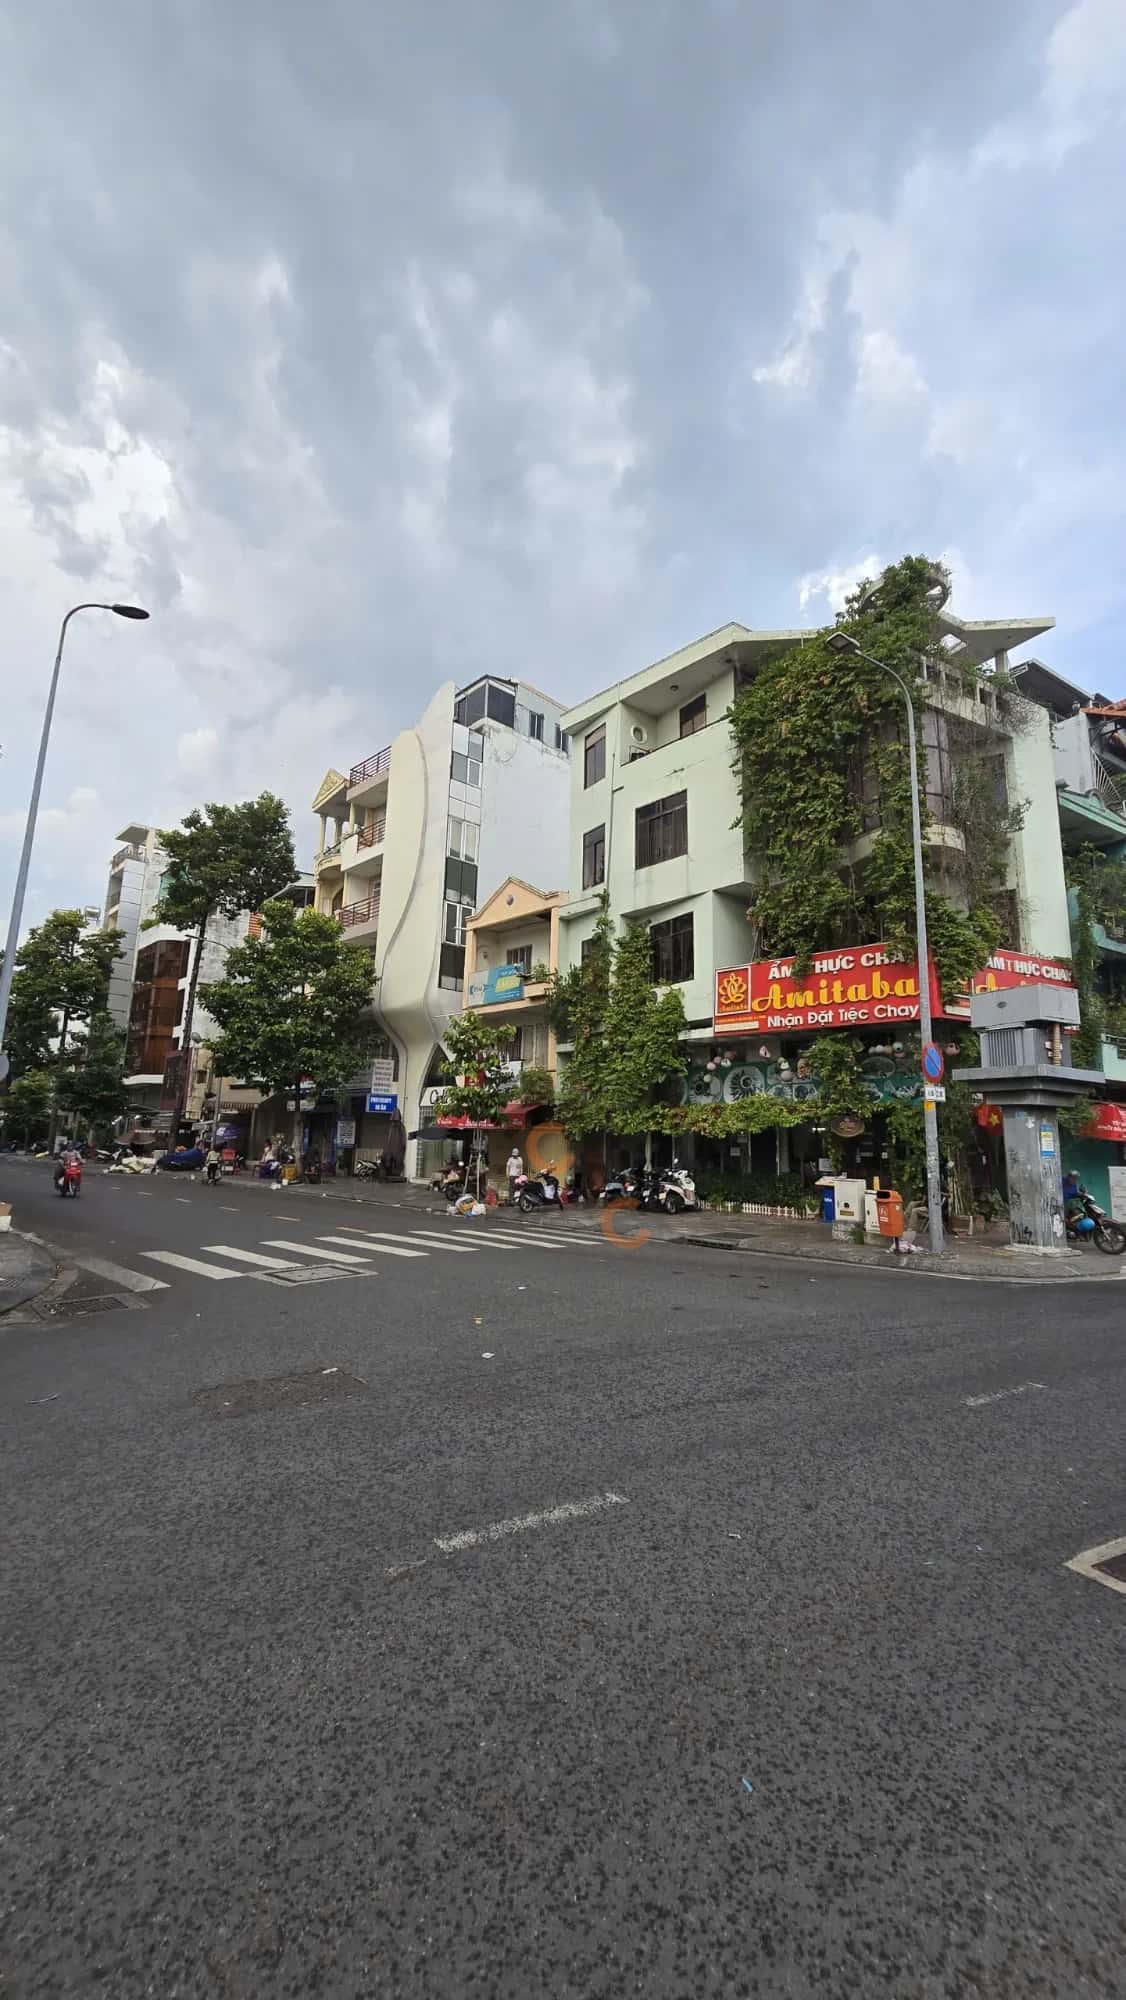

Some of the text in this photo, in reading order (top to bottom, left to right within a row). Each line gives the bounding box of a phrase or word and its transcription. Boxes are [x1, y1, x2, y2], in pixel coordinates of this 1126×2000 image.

[811, 955, 855, 974] HỰC
[860, 950, 906, 967] CHA
[751, 971, 920, 1012] Amitaba
[767, 1012, 803, 1029] Nhận
[807, 1009, 834, 1026] Đặt
[839, 1007, 869, 1023] Tiệc
[874, 1004, 919, 1020] Chay
